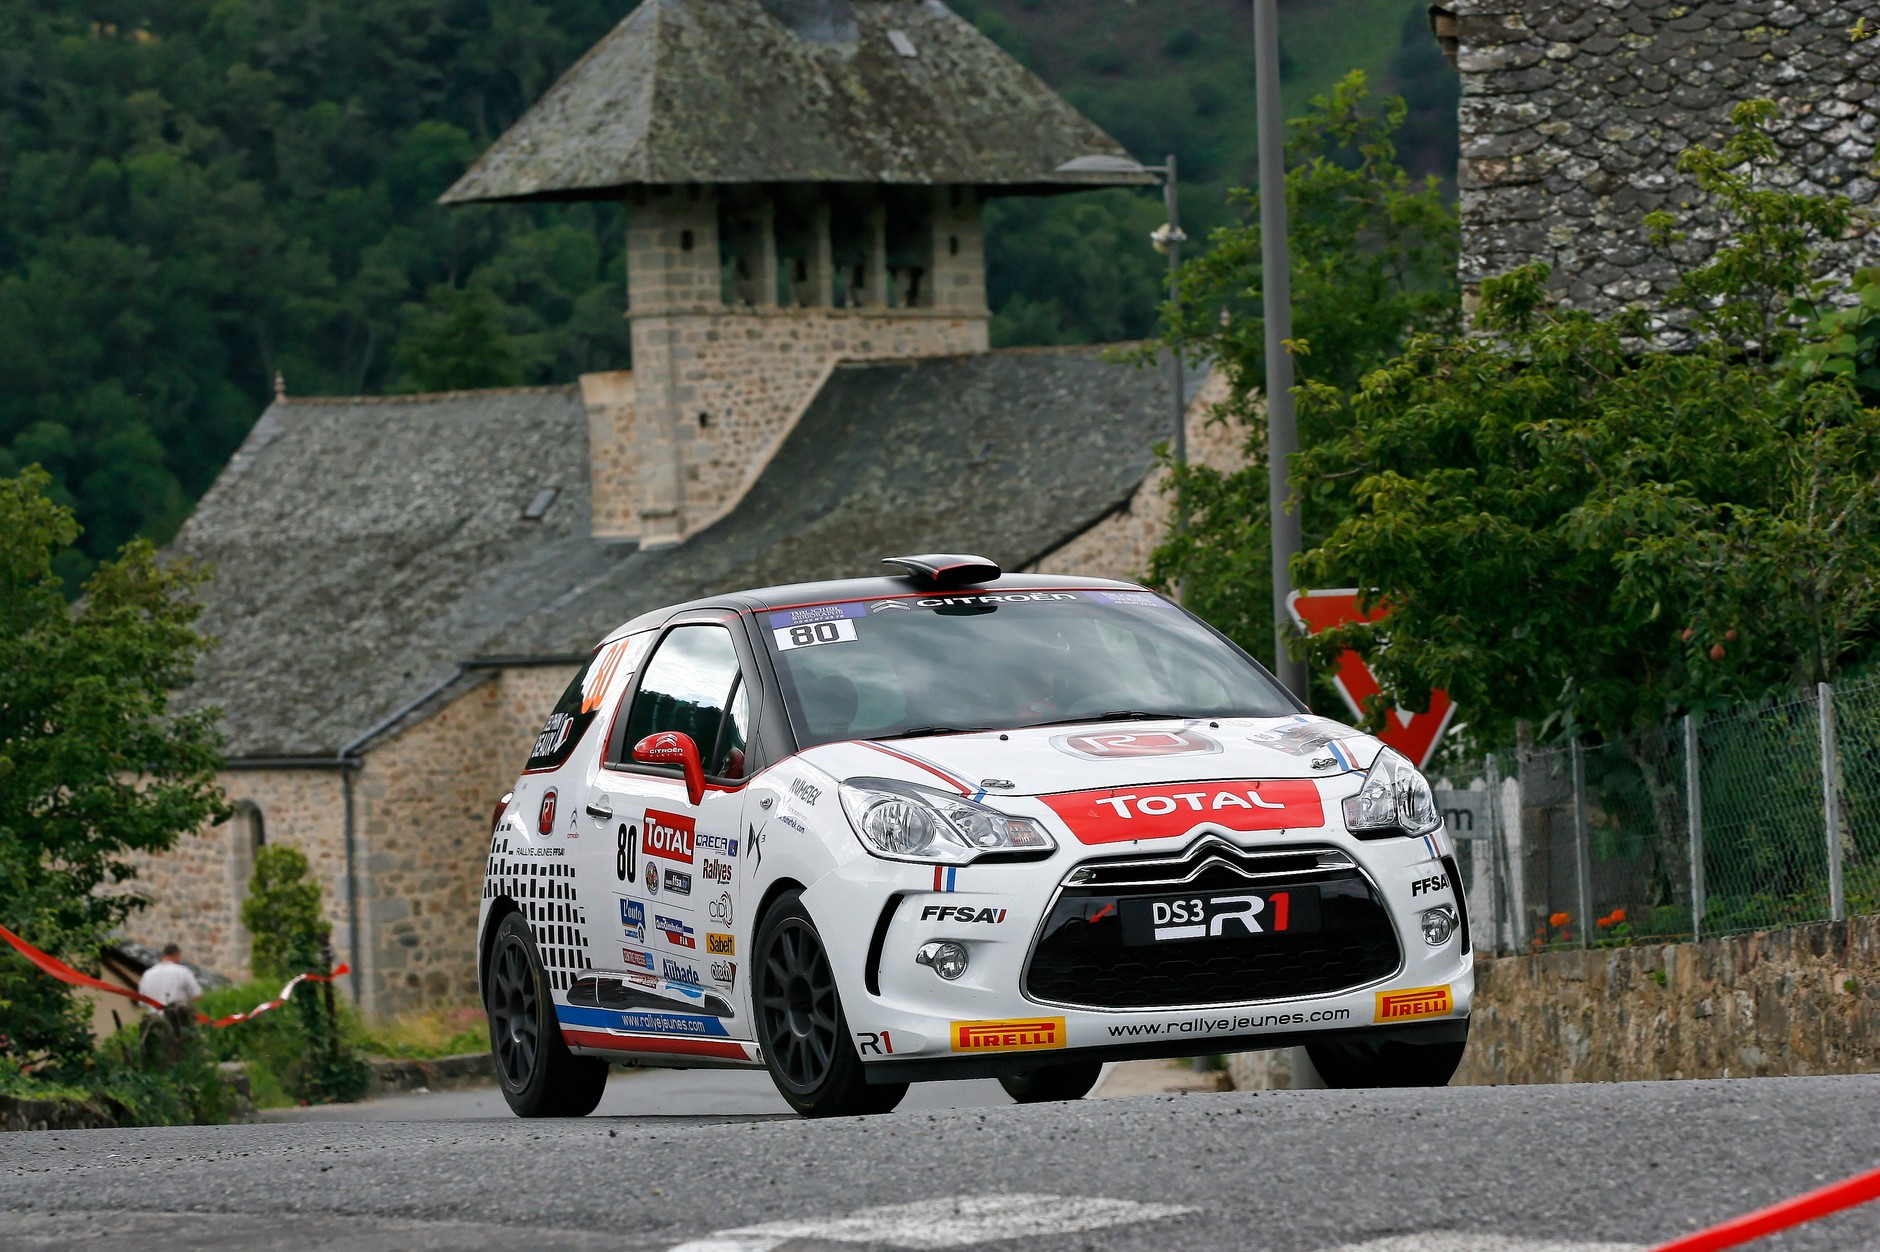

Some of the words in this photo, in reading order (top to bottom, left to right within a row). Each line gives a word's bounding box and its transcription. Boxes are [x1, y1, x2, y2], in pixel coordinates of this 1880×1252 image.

[916, 592, 1077, 608] CITROËN
[789, 623, 840, 646] 80
[581, 637, 630, 715] 80
[1096, 790, 1285, 819] TOTAL
[645, 818, 692, 856] TOTAL
[696, 833, 728, 850] ORECA
[616, 823, 637, 883] 80
[703, 858, 732, 885] Rallyes
[920, 905, 997, 923] FFSA
[1152, 899, 1204, 925] DS3
[1210, 892, 1290, 936] R1
[709, 934, 733, 954] Sabelt
[663, 958, 700, 986] Aubade
[1382, 990, 1448, 1018] PIRELLI
[622, 1014, 706, 1033] www.rallyejeunes.com
[959, 1022, 1056, 1049] PIRELLI
[1108, 1007, 1351, 1037] www.rallyejeunes.com
[857, 1031, 893, 1055] R1
